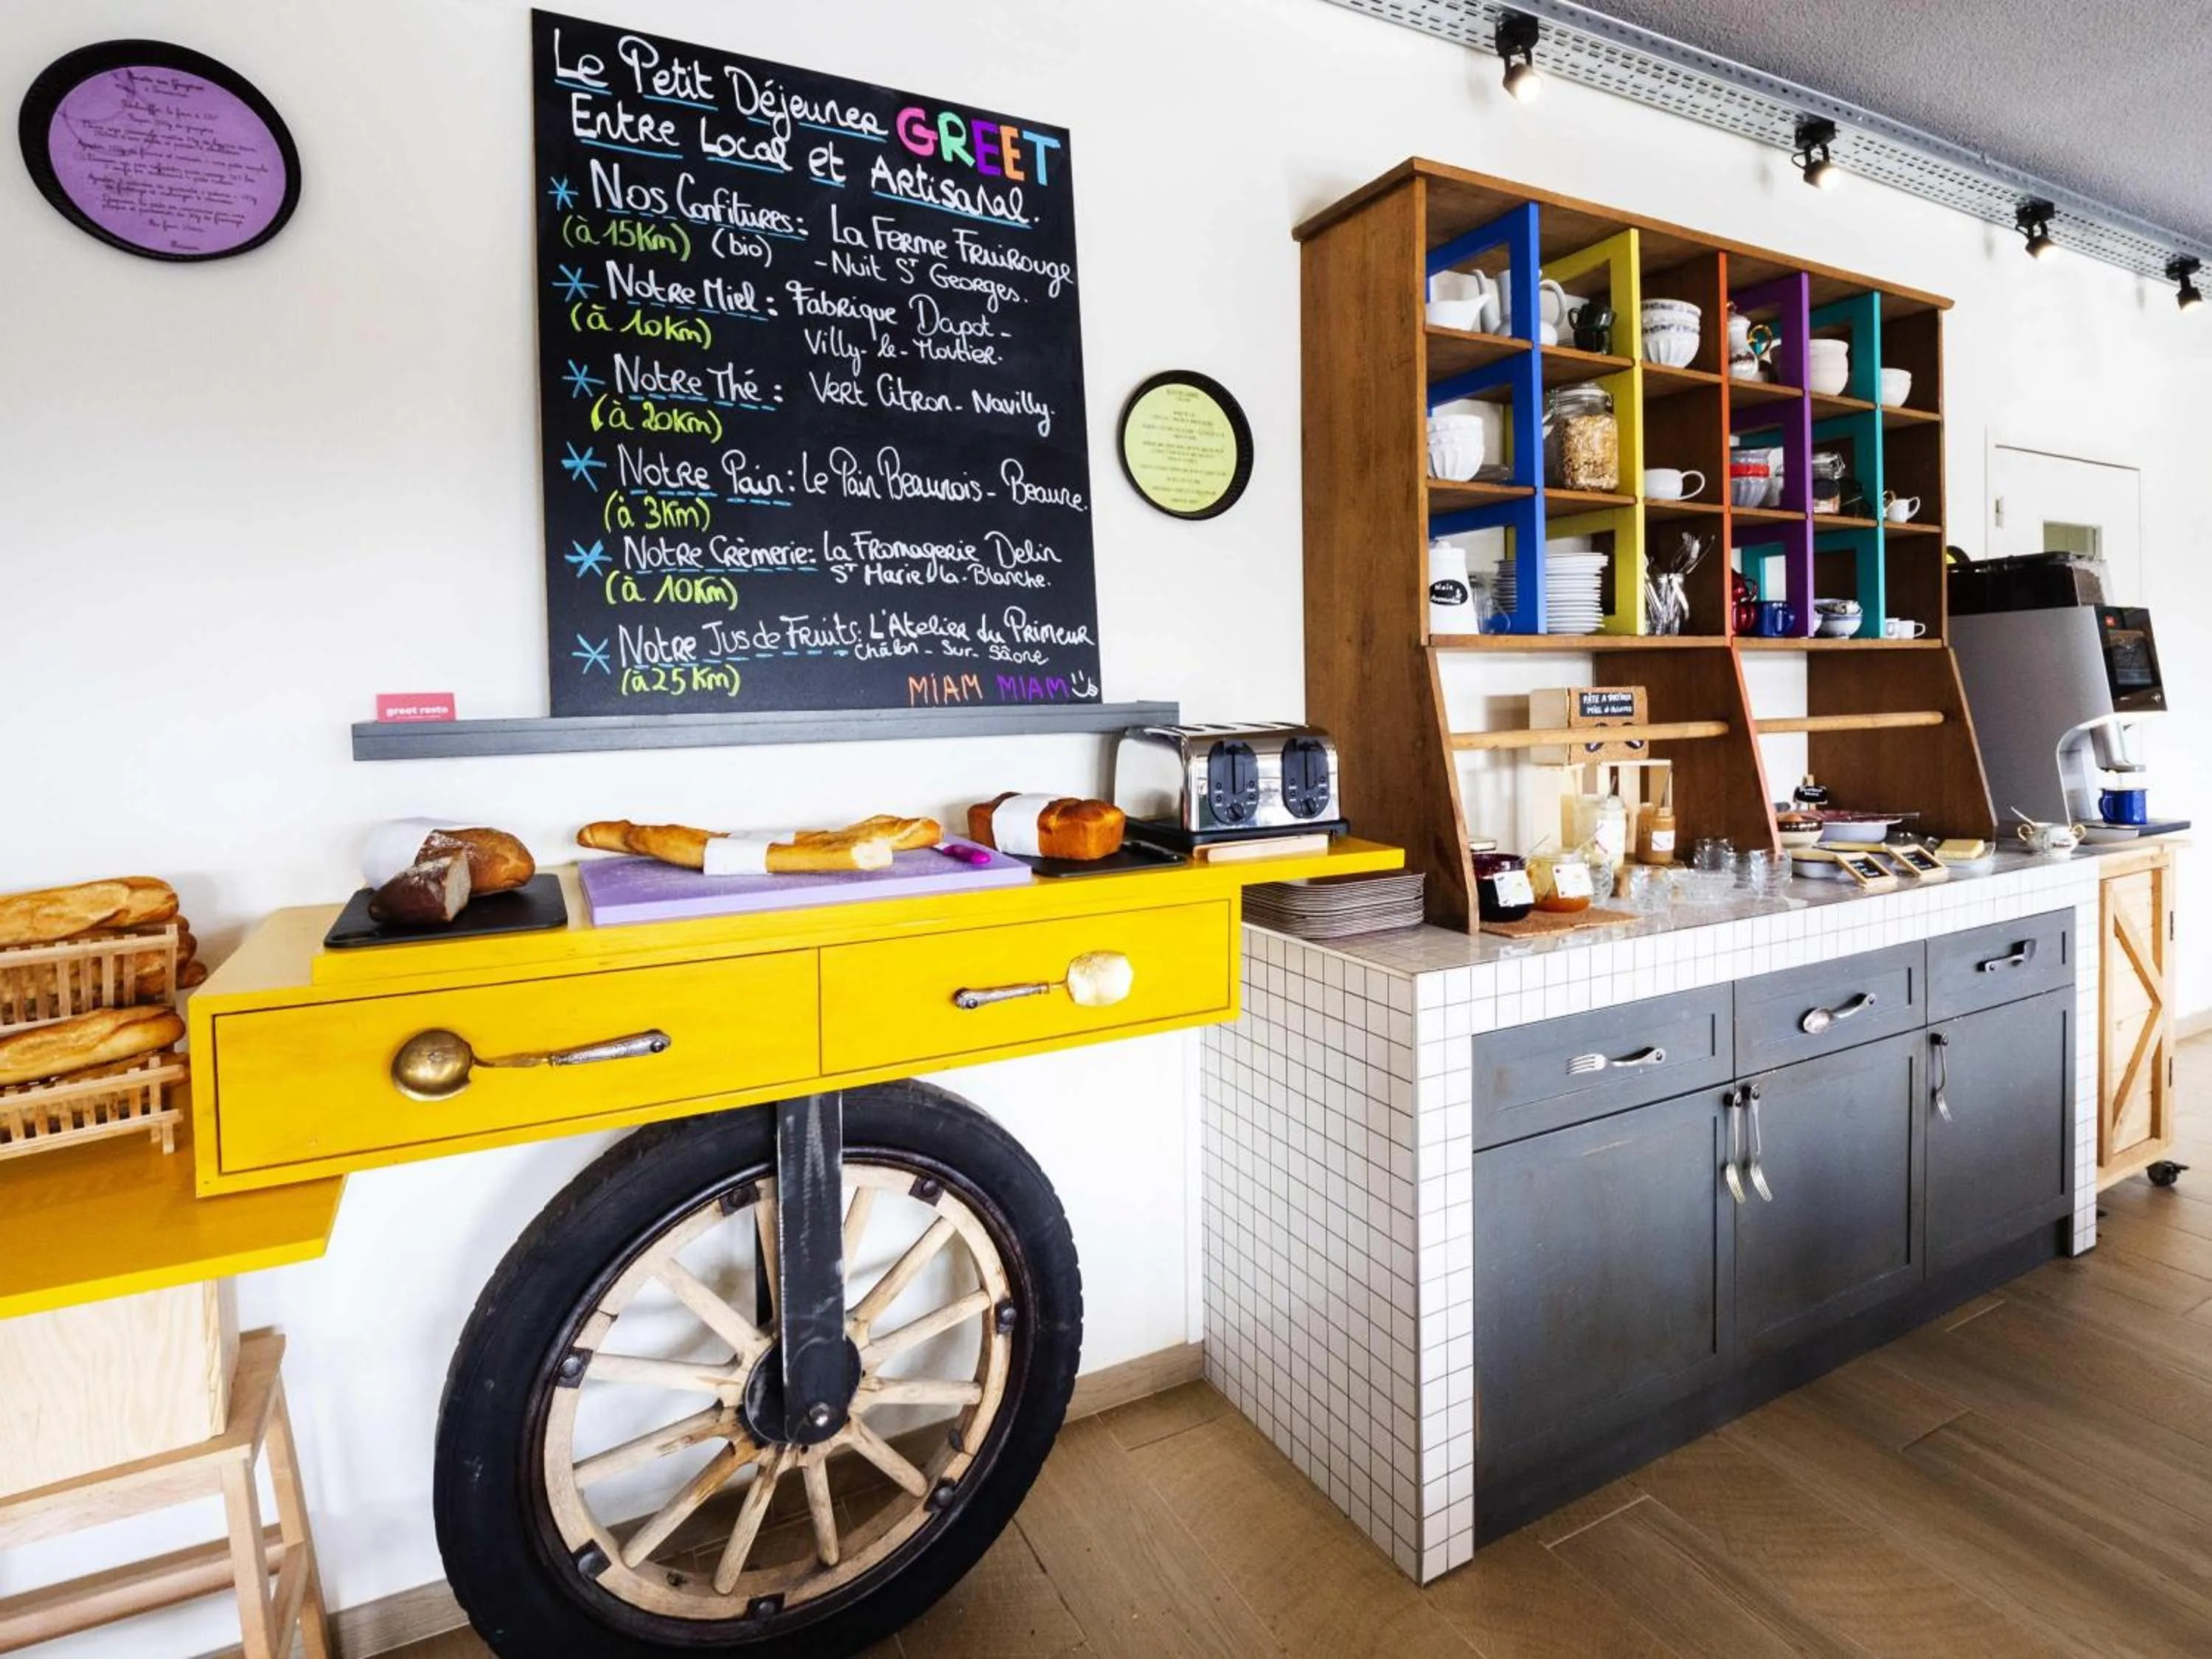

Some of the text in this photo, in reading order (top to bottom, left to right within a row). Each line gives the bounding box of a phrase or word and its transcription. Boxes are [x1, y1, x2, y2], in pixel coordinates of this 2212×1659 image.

[554, 28, 1061, 186] Le Petit Déjeuner GREET
[571, 92, 681, 147] Entre
[700, 116, 793, 171] Local
[808, 141, 846, 182] et
[590, 159, 669, 214] Nos
[712, 228, 772, 268] (bio)
[830, 204, 868, 248] La
[872, 215, 950, 260] Ferme
[605, 260, 697, 305] Notre
[785, 279, 898, 341] Fabrique
[613, 352, 703, 394] Notre
[810, 371, 869, 407] Vert
[617, 442, 711, 490] Notre
[830, 446, 882, 500] Pain
[624, 535, 704, 570] Notre
[850, 530, 980, 582] Fromagerie
[984, 530, 1062, 569] Delin
[864, 563, 924, 585] Marie
[618, 625, 698, 668] Notre
[869, 608, 970, 641] L'Atelier
[977, 613, 1003, 644] du
[1004, 605, 1095, 646] Primeur
